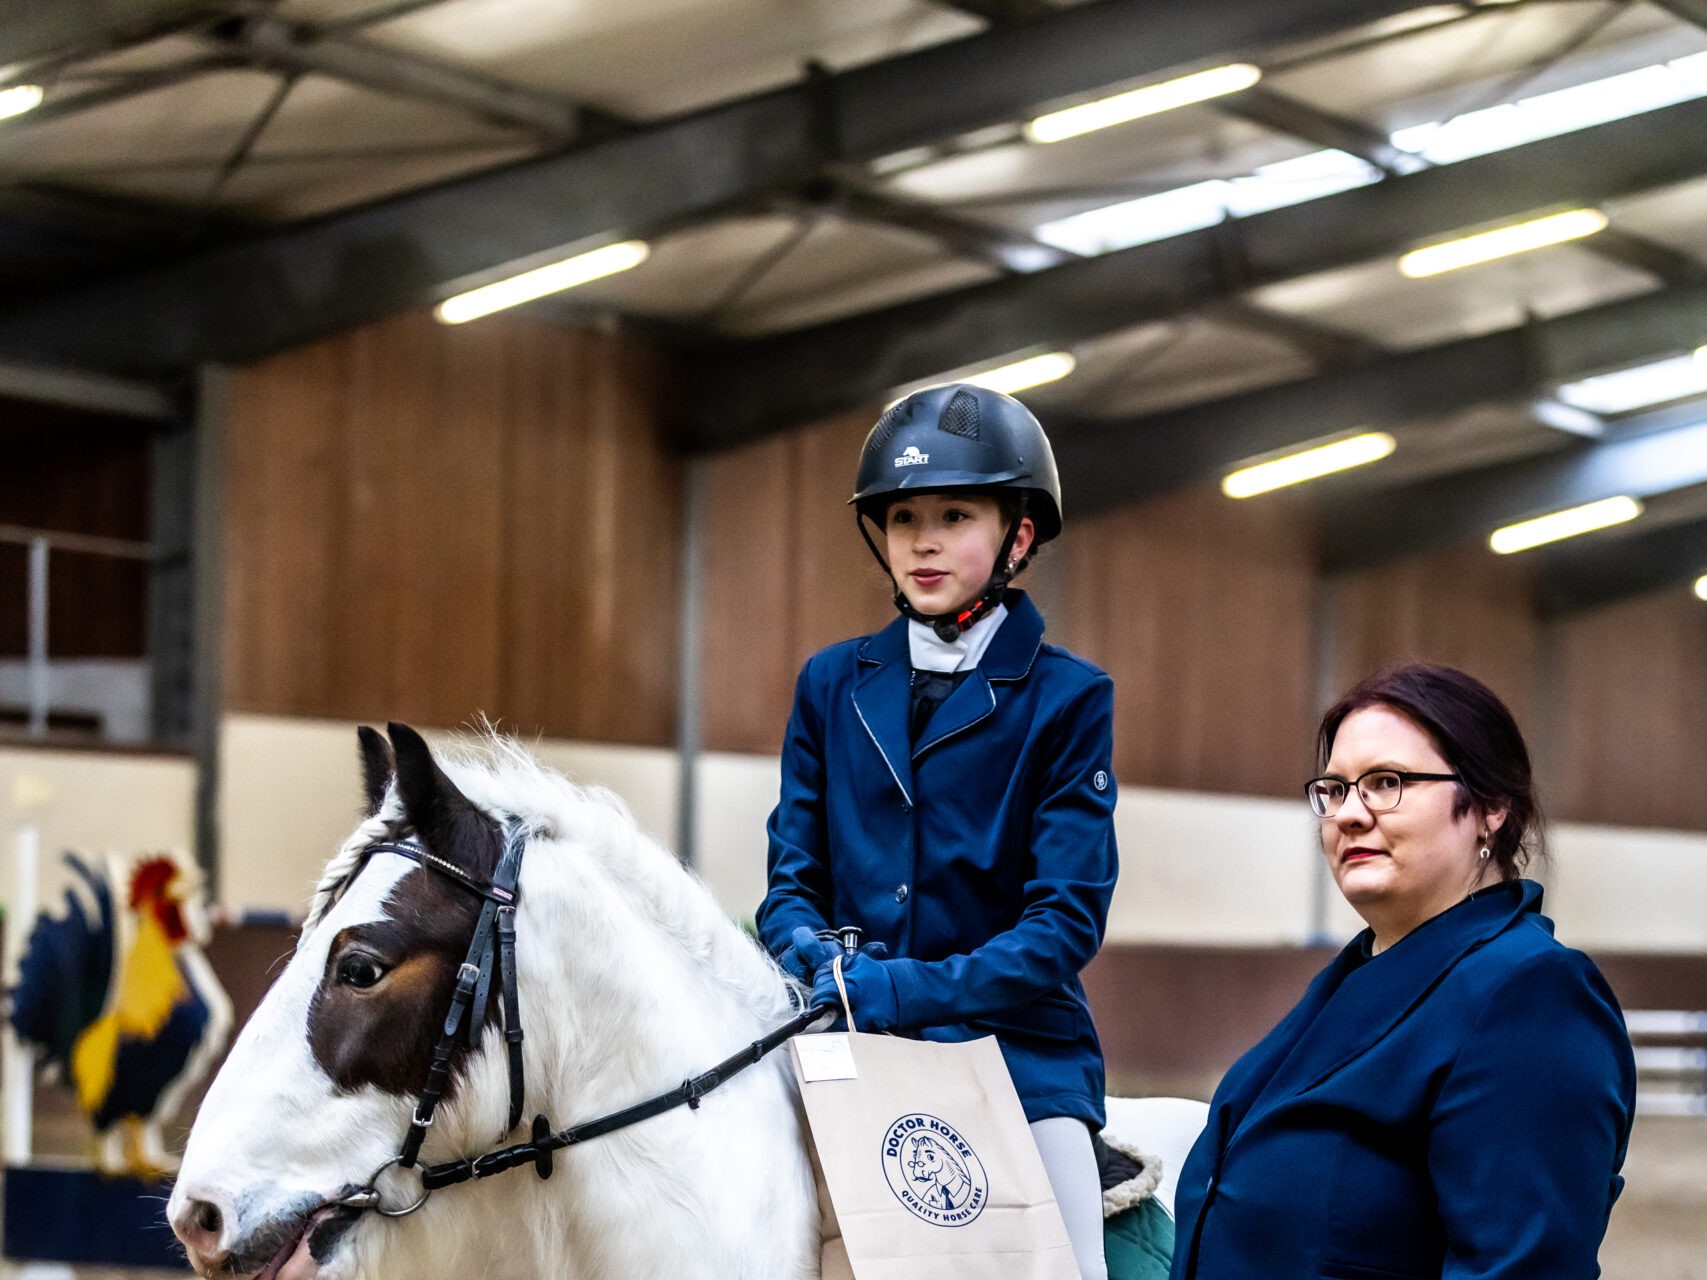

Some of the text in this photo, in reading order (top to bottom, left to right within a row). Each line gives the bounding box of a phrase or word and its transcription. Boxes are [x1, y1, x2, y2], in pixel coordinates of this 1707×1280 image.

[894, 453, 930, 467] START
[886, 1118, 972, 1158] DOCTOR HORSE
[901, 1187, 983, 1222] QUALITY HORSE CARE
